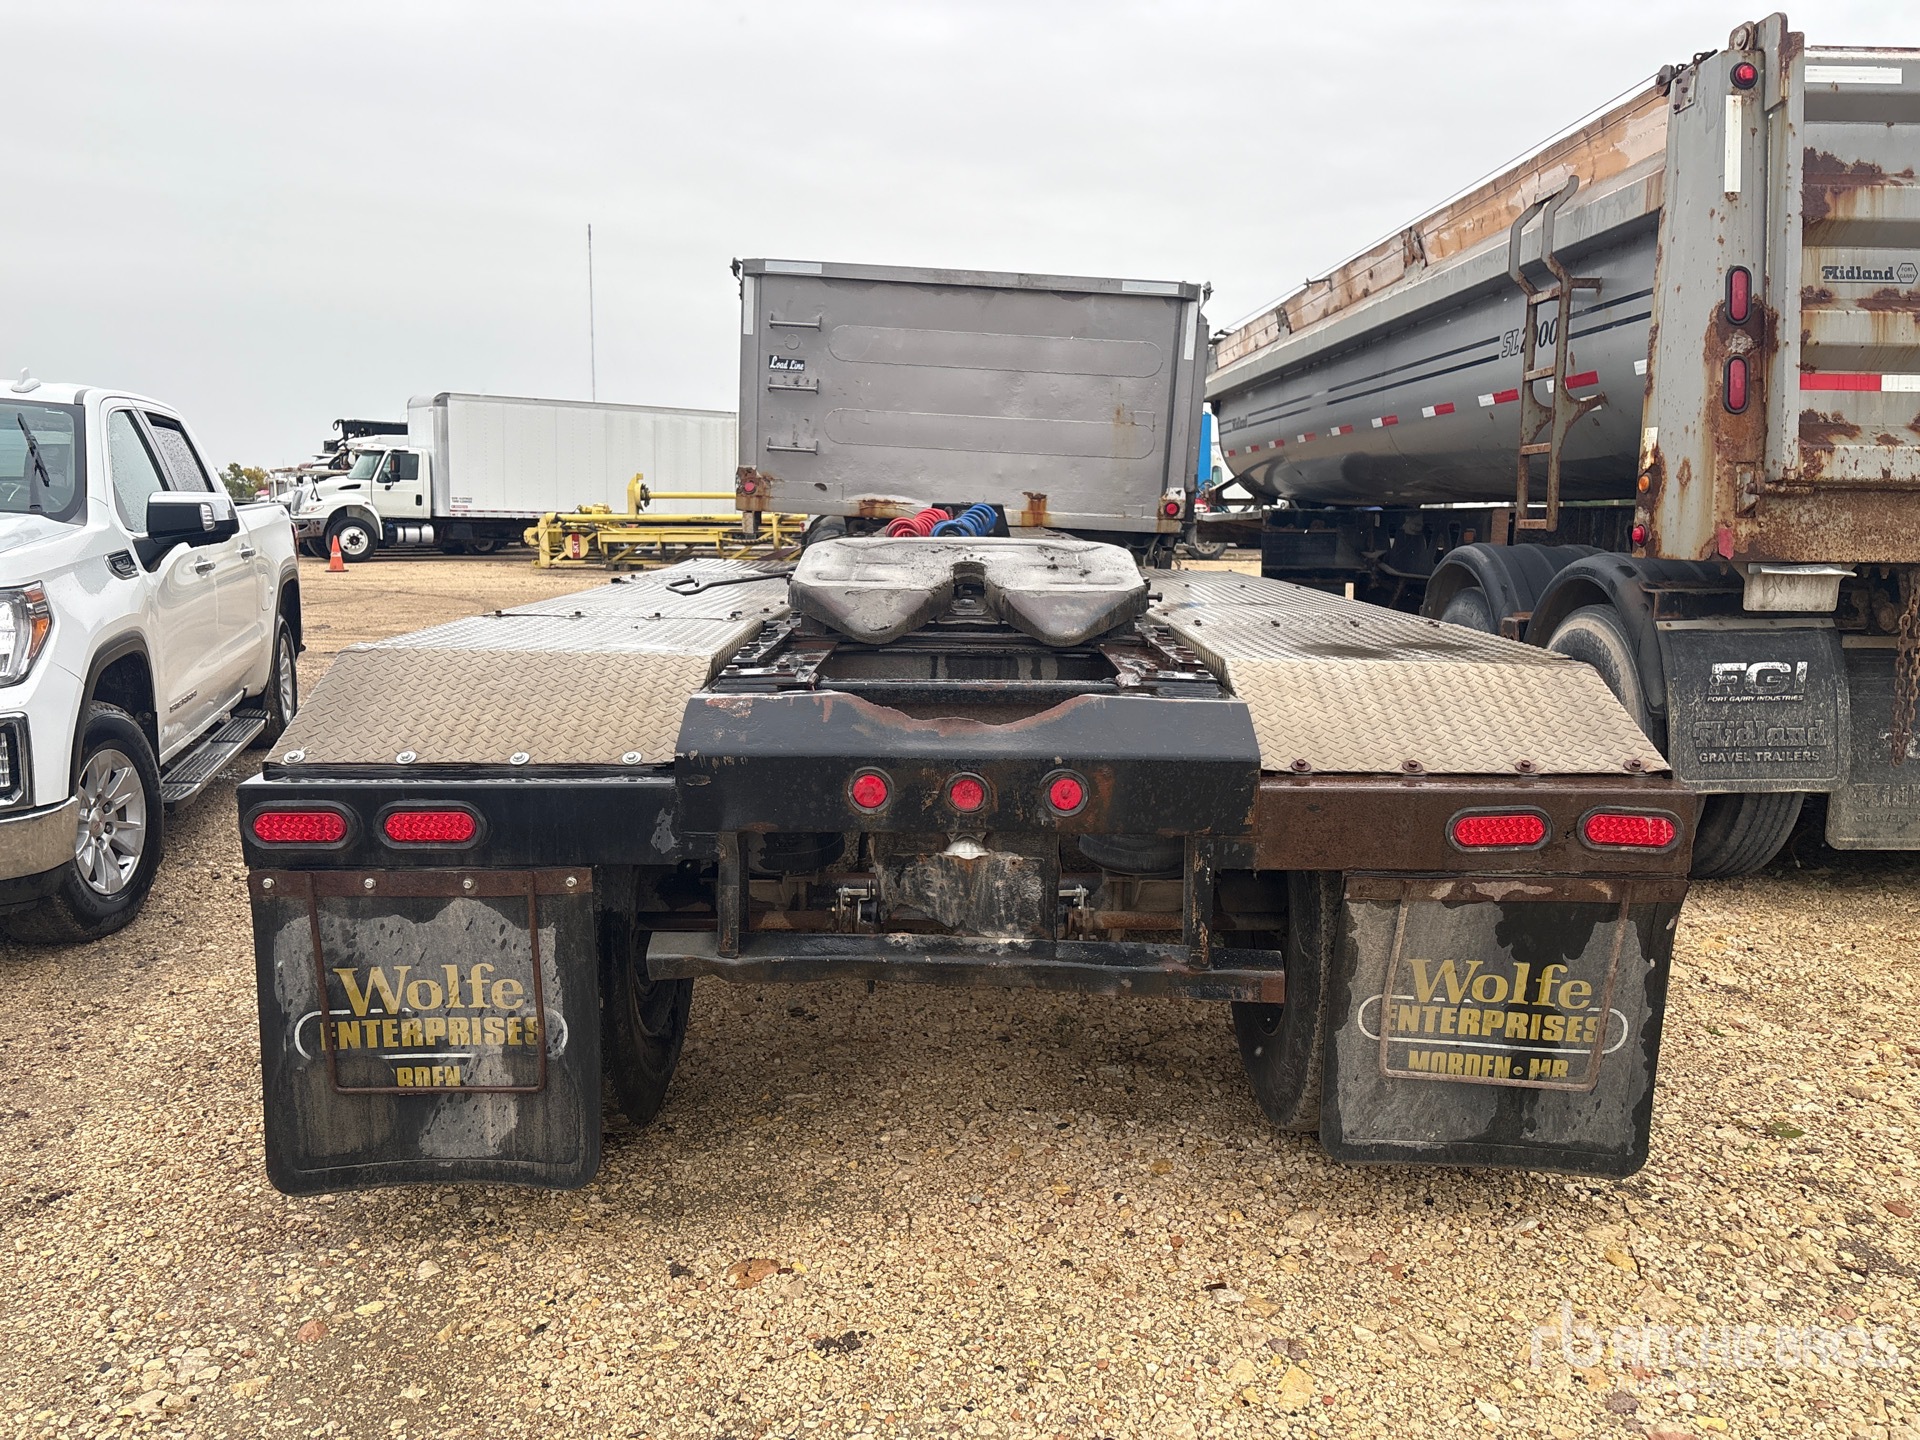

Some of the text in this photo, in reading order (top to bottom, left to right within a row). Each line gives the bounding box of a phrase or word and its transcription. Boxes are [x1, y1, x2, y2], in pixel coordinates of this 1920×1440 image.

[1821, 265, 1895, 281] Midland
[769, 355, 804, 370] Load Line
[1708, 661, 1808, 695] FGI
[1692, 720, 1826, 747] Midland
[1699, 751, 1820, 762] GRAVEL TRAILERS
[332, 963, 524, 1017] Wolfe
[1410, 959, 1592, 1010] Wolfe
[320, 1016, 540, 1051] ENTERPRISES
[1388, 1004, 1600, 1043] ENTERPRISES
